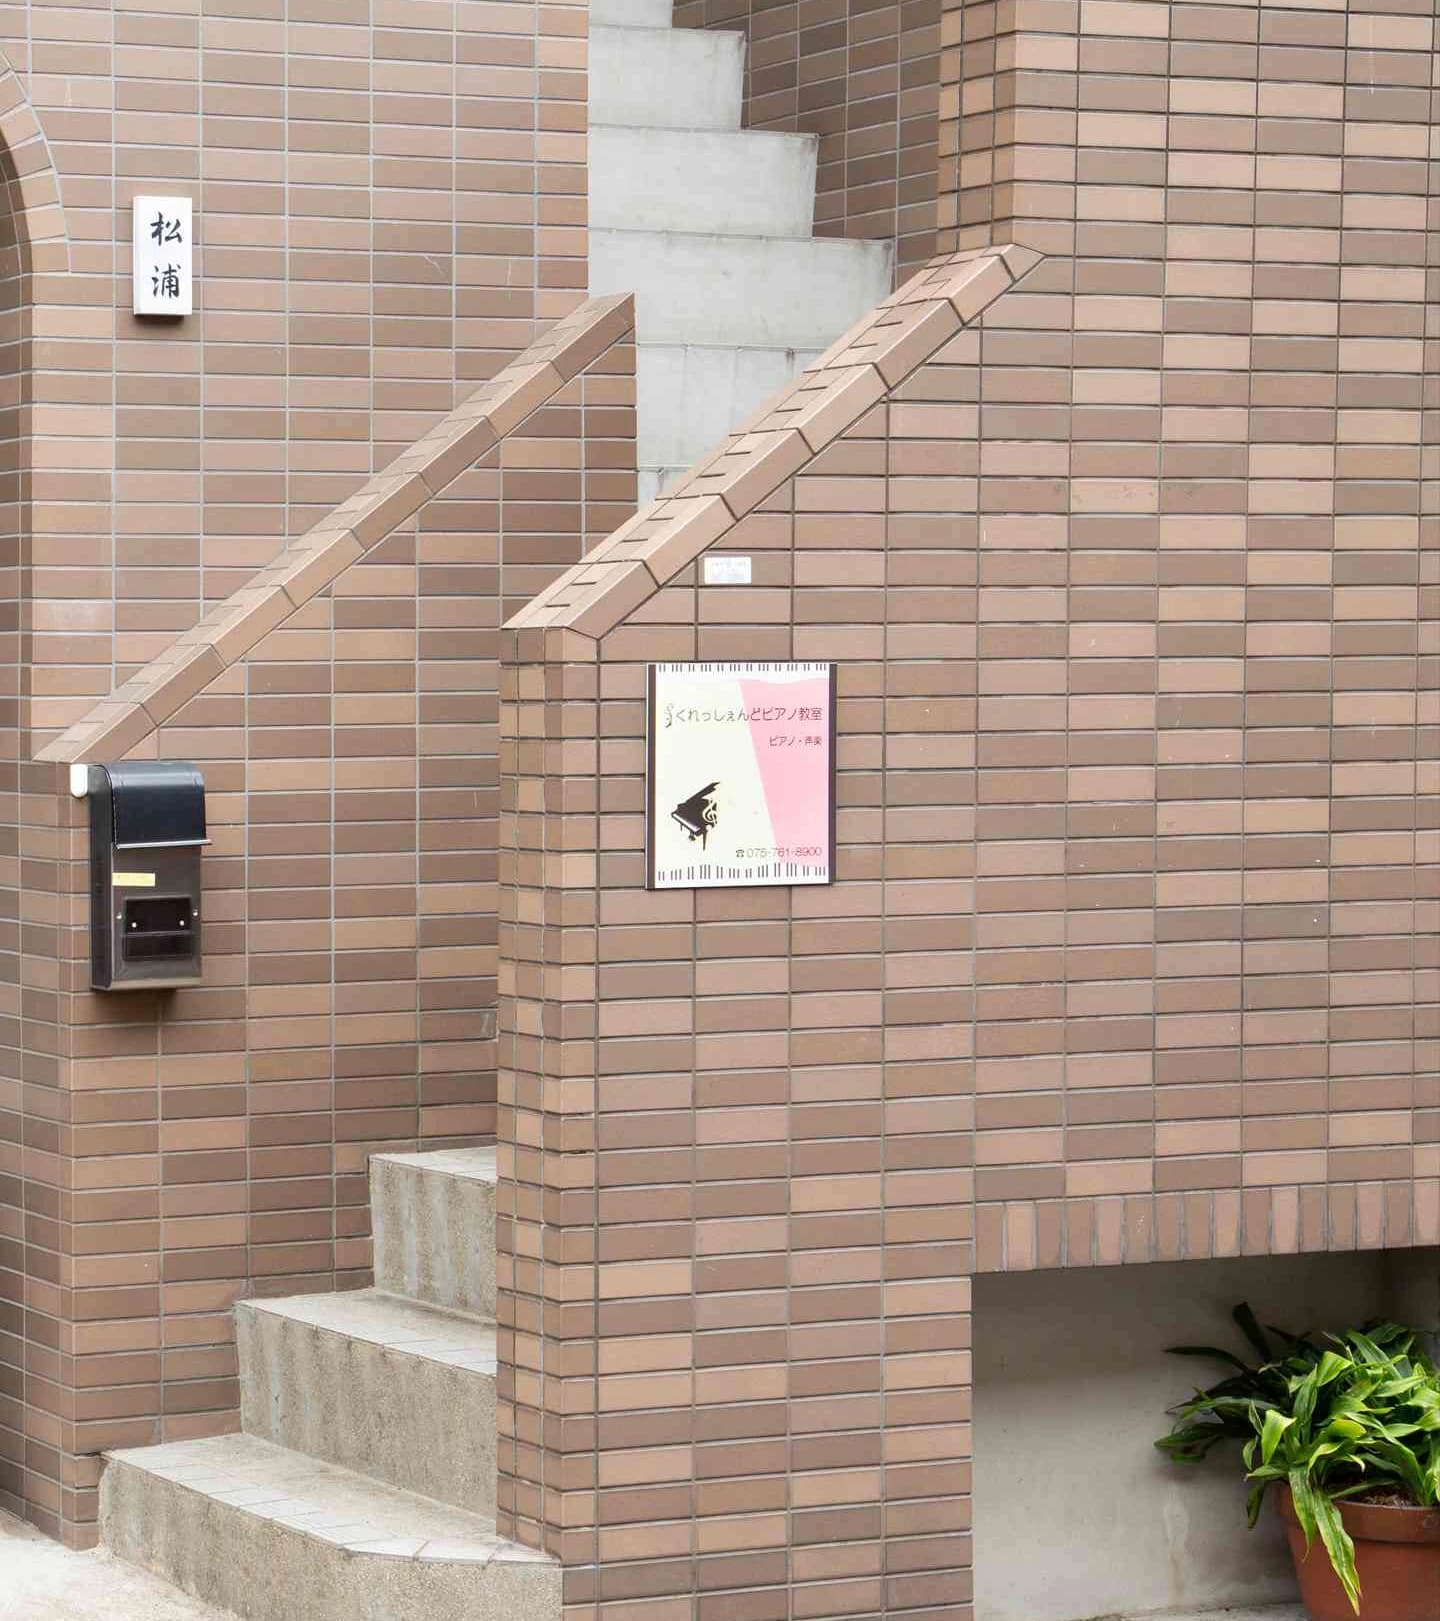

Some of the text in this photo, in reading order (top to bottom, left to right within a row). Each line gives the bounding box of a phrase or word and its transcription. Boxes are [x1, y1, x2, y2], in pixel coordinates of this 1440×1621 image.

[150, 211, 183, 299] 松浦
[676, 707, 823, 722] くれっしぇんどピアノ教室
